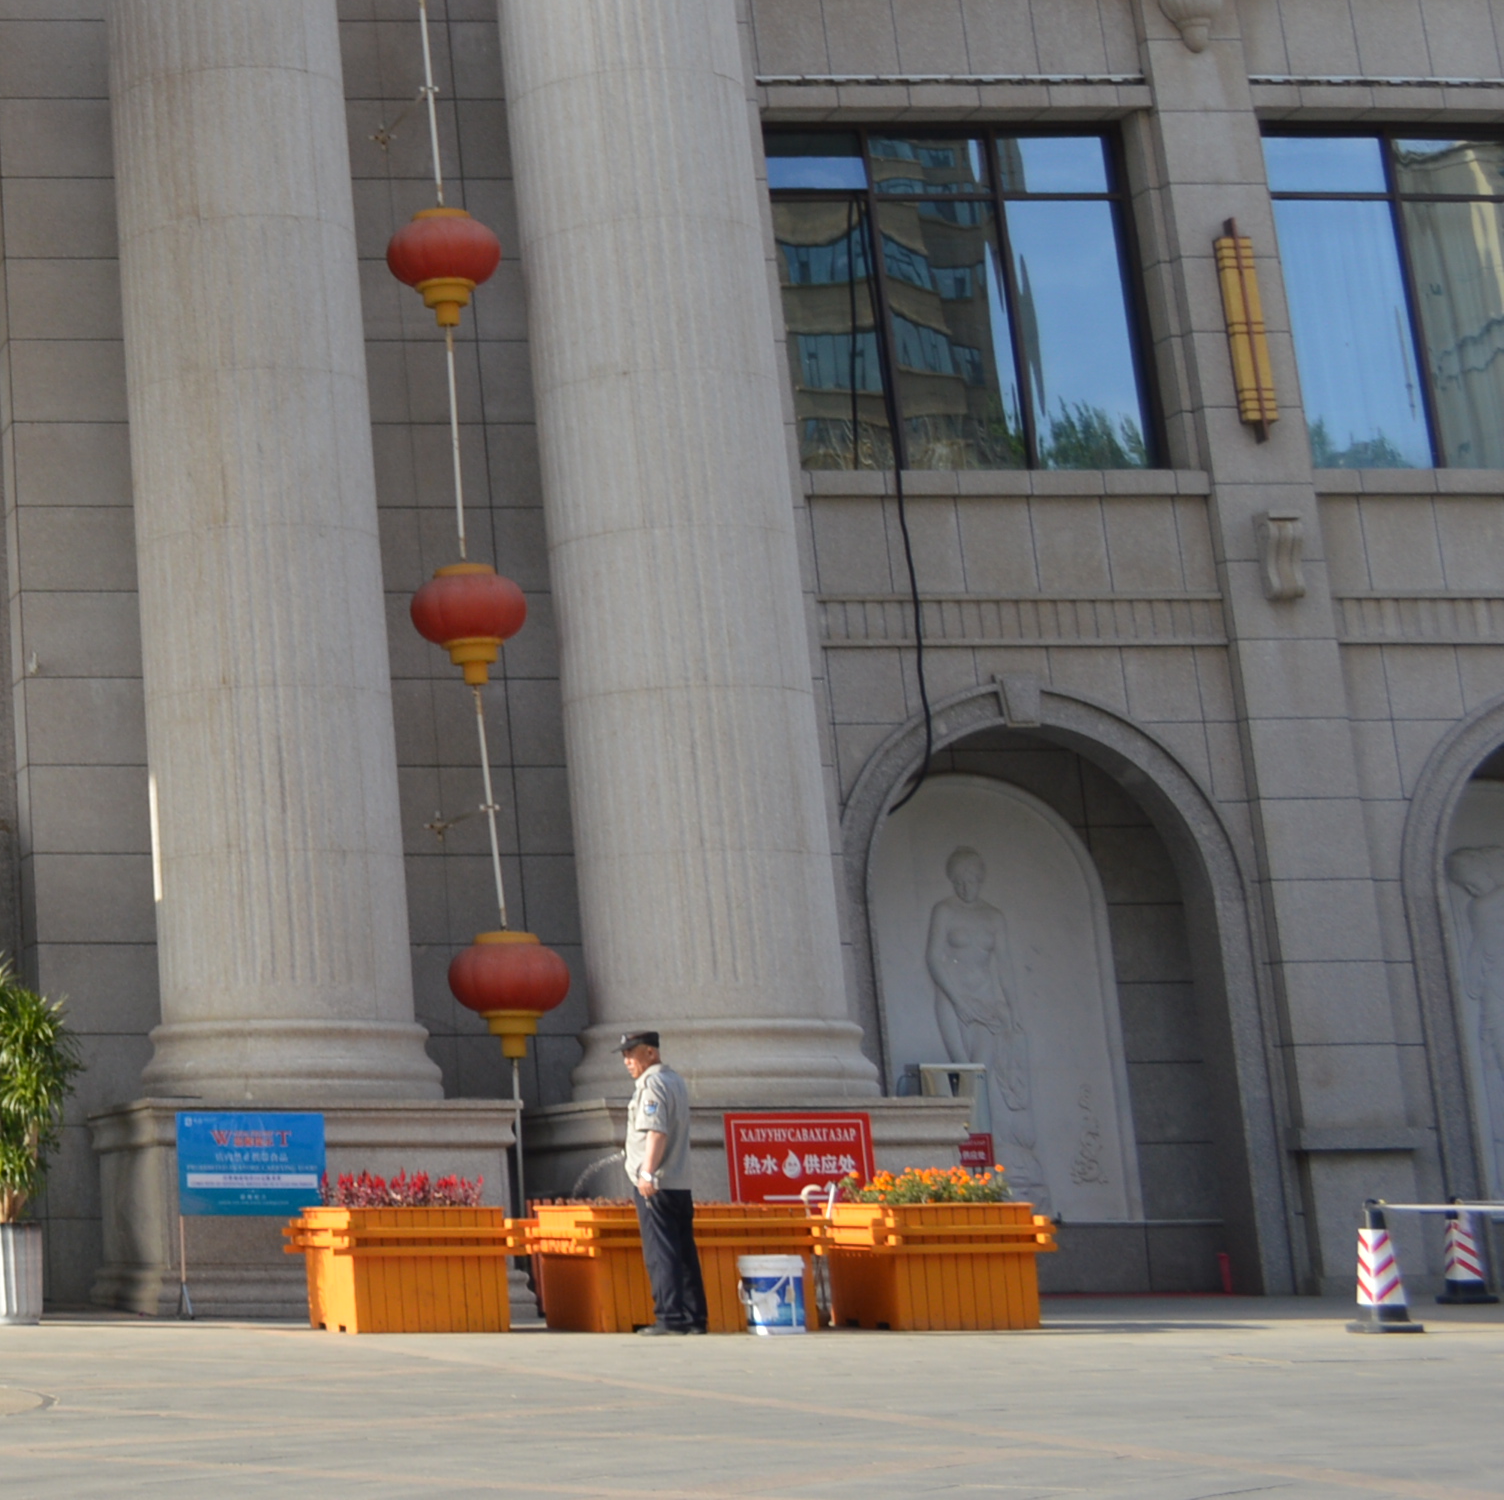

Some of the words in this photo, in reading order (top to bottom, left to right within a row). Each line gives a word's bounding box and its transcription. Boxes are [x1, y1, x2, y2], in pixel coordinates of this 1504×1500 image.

[743, 1153, 779, 1175] 热水
[803, 1153, 857, 1175] 供应处
